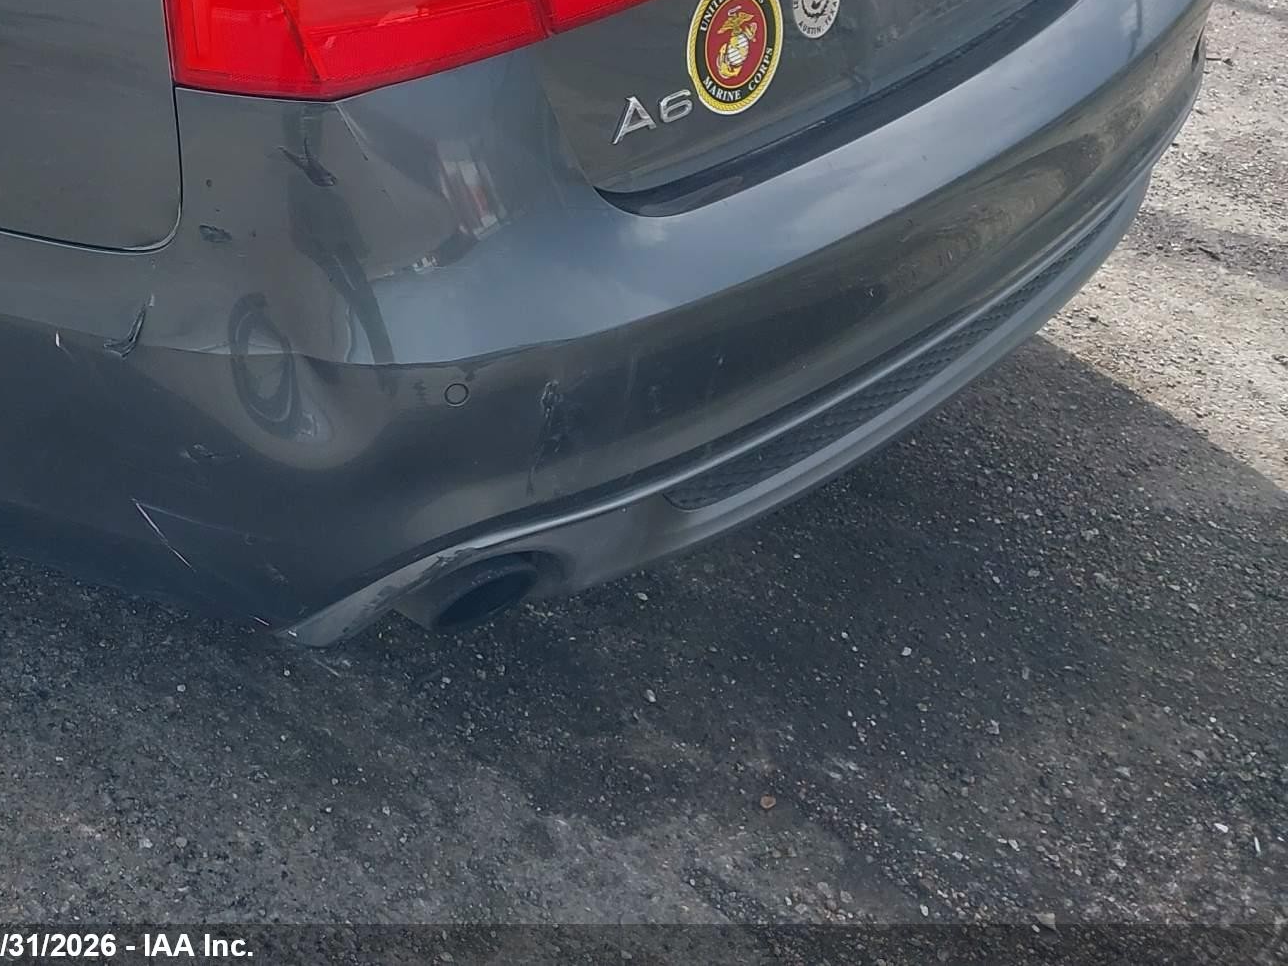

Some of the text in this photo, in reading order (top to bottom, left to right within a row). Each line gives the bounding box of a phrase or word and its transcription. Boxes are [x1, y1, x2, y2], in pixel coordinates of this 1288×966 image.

[702, 47, 773, 102] MARINE CORPS
[610, 89, 693, 146] A6
